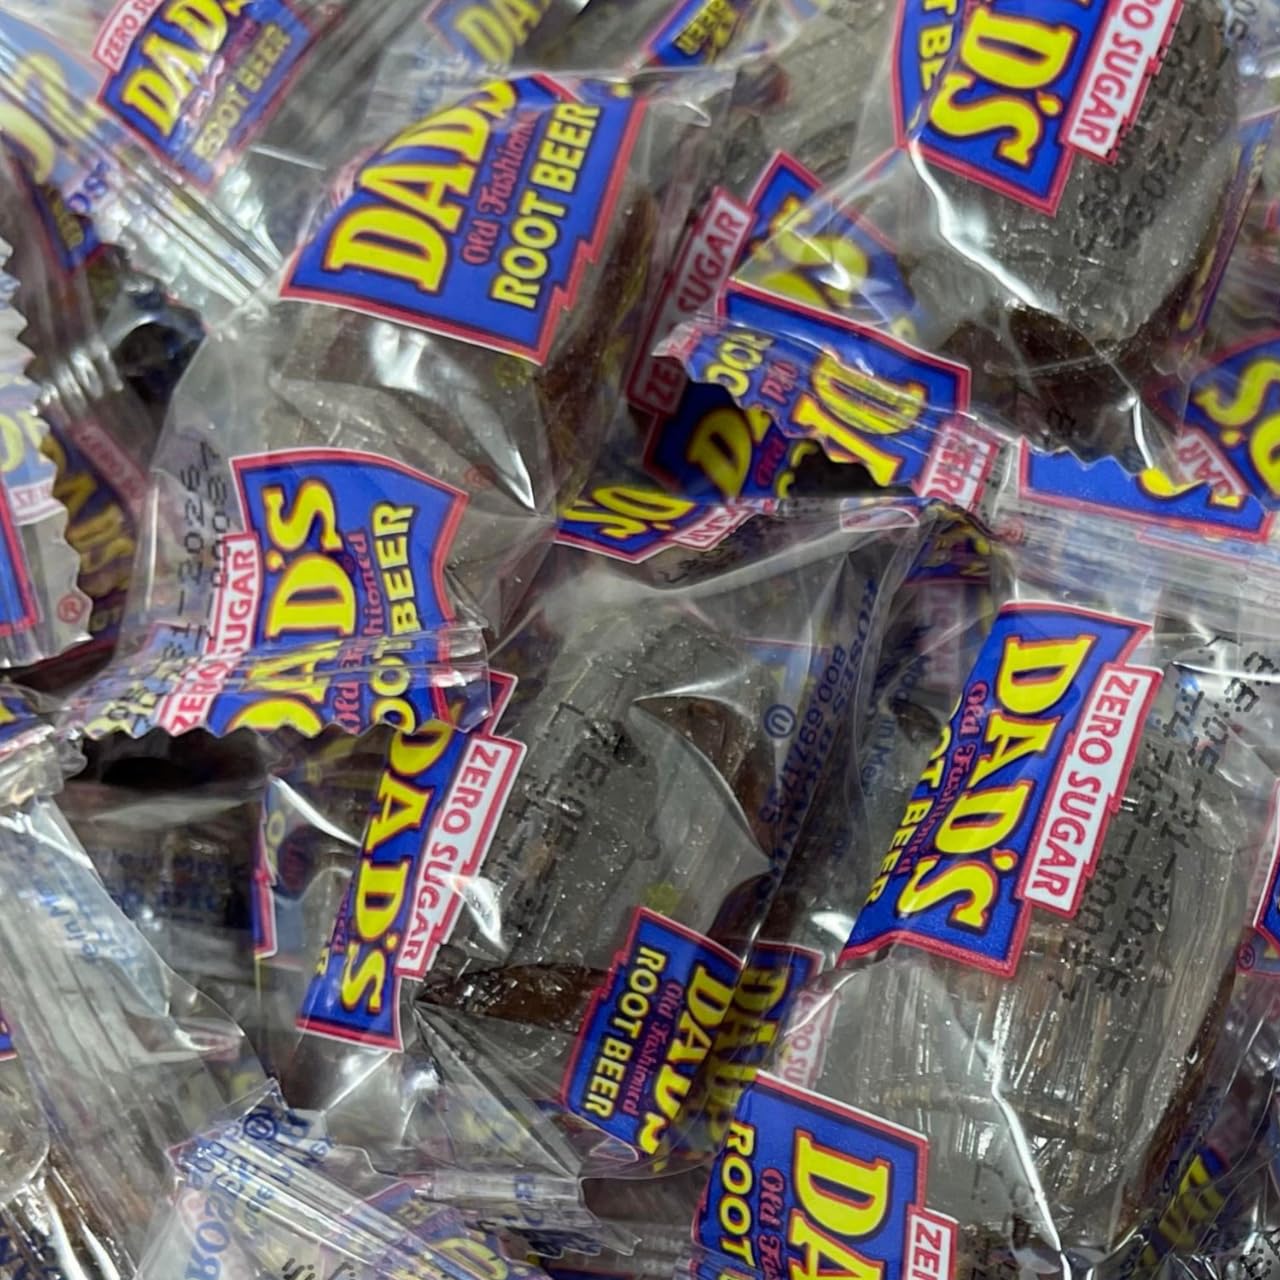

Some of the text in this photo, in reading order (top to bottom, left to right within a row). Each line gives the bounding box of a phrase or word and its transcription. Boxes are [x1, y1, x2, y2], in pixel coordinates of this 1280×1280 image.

[1070, 25, 1145, 143] SUGAR
[463, 221, 500, 265] Old
[491, 103, 601, 308] ROOT BEER
[677, 208, 747, 318] SUGAR
[222, 547, 258, 665] SUGAR
[374, 504, 414, 632] BEER
[402, 738, 500, 965] ZERO SUGAR
[896, 636, 1096, 932] DAD'S
[1032, 672, 1138, 898] ZERO SUGAR
[342, 720, 455, 1014] DAD'S
[582, 945, 666, 1118] ROOT BEER
[718, 1122, 755, 1268] ROOT
[760, 1167, 785, 1227] Old
